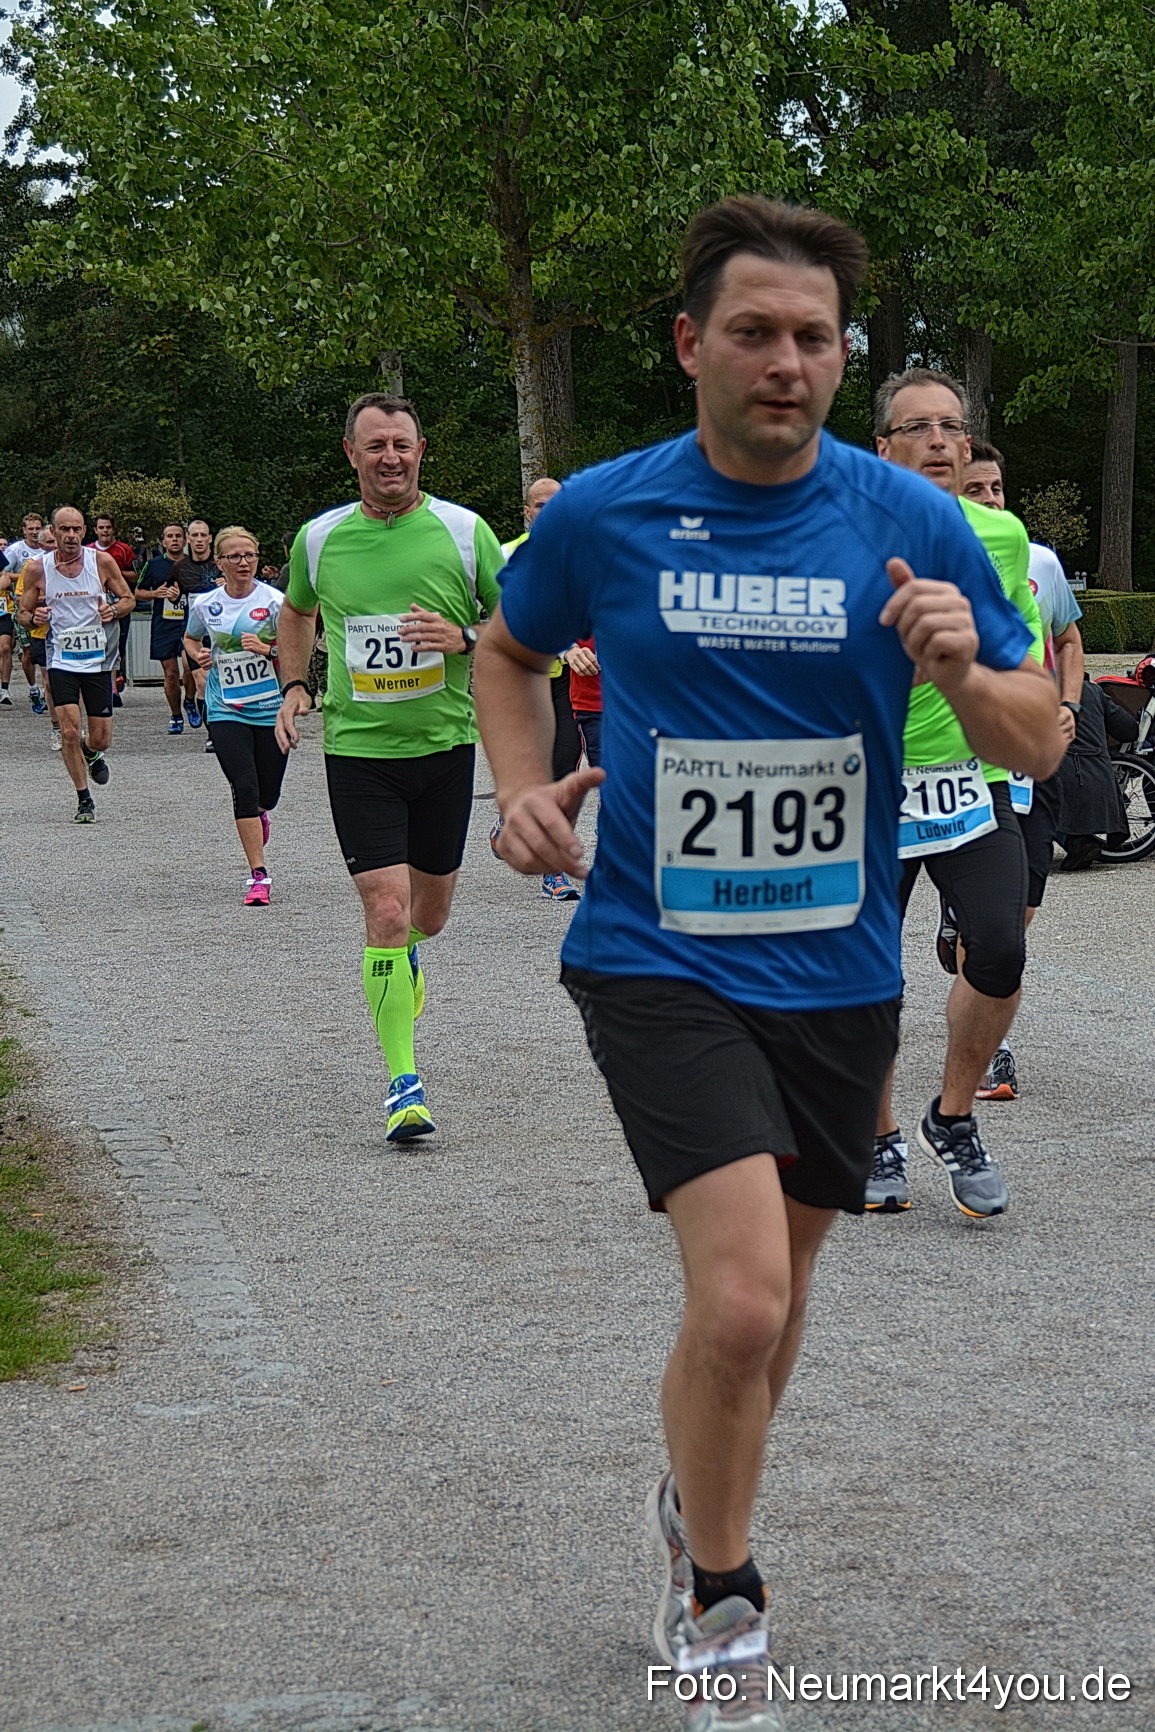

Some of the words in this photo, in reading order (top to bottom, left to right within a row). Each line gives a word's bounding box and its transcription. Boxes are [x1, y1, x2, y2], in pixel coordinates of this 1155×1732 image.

[670, 529, 710, 541] erima
[659, 570, 847, 617] HUBER
[348, 624, 375, 633] PARTL
[699, 616, 839, 634] TECHNOLOGY
[63, 634, 99, 650] 2411
[697, 636, 741, 650] WASTE
[743, 638, 787, 652] WATER
[790, 640, 841, 653] Solutions
[218, 656, 233, 665] PARTL
[234, 653, 261, 663] Neumarkt
[224, 660, 270, 685] 3102
[374, 677, 420, 690] Werner
[663, 757, 732, 778] PARTL
[737, 760, 835, 778] Neumarkt
[916, 764, 964, 775] Neumarkt
[681, 786, 846, 858] 2193
[916, 819, 966, 840] Ludwig
[713, 876, 813, 905] Herbert
